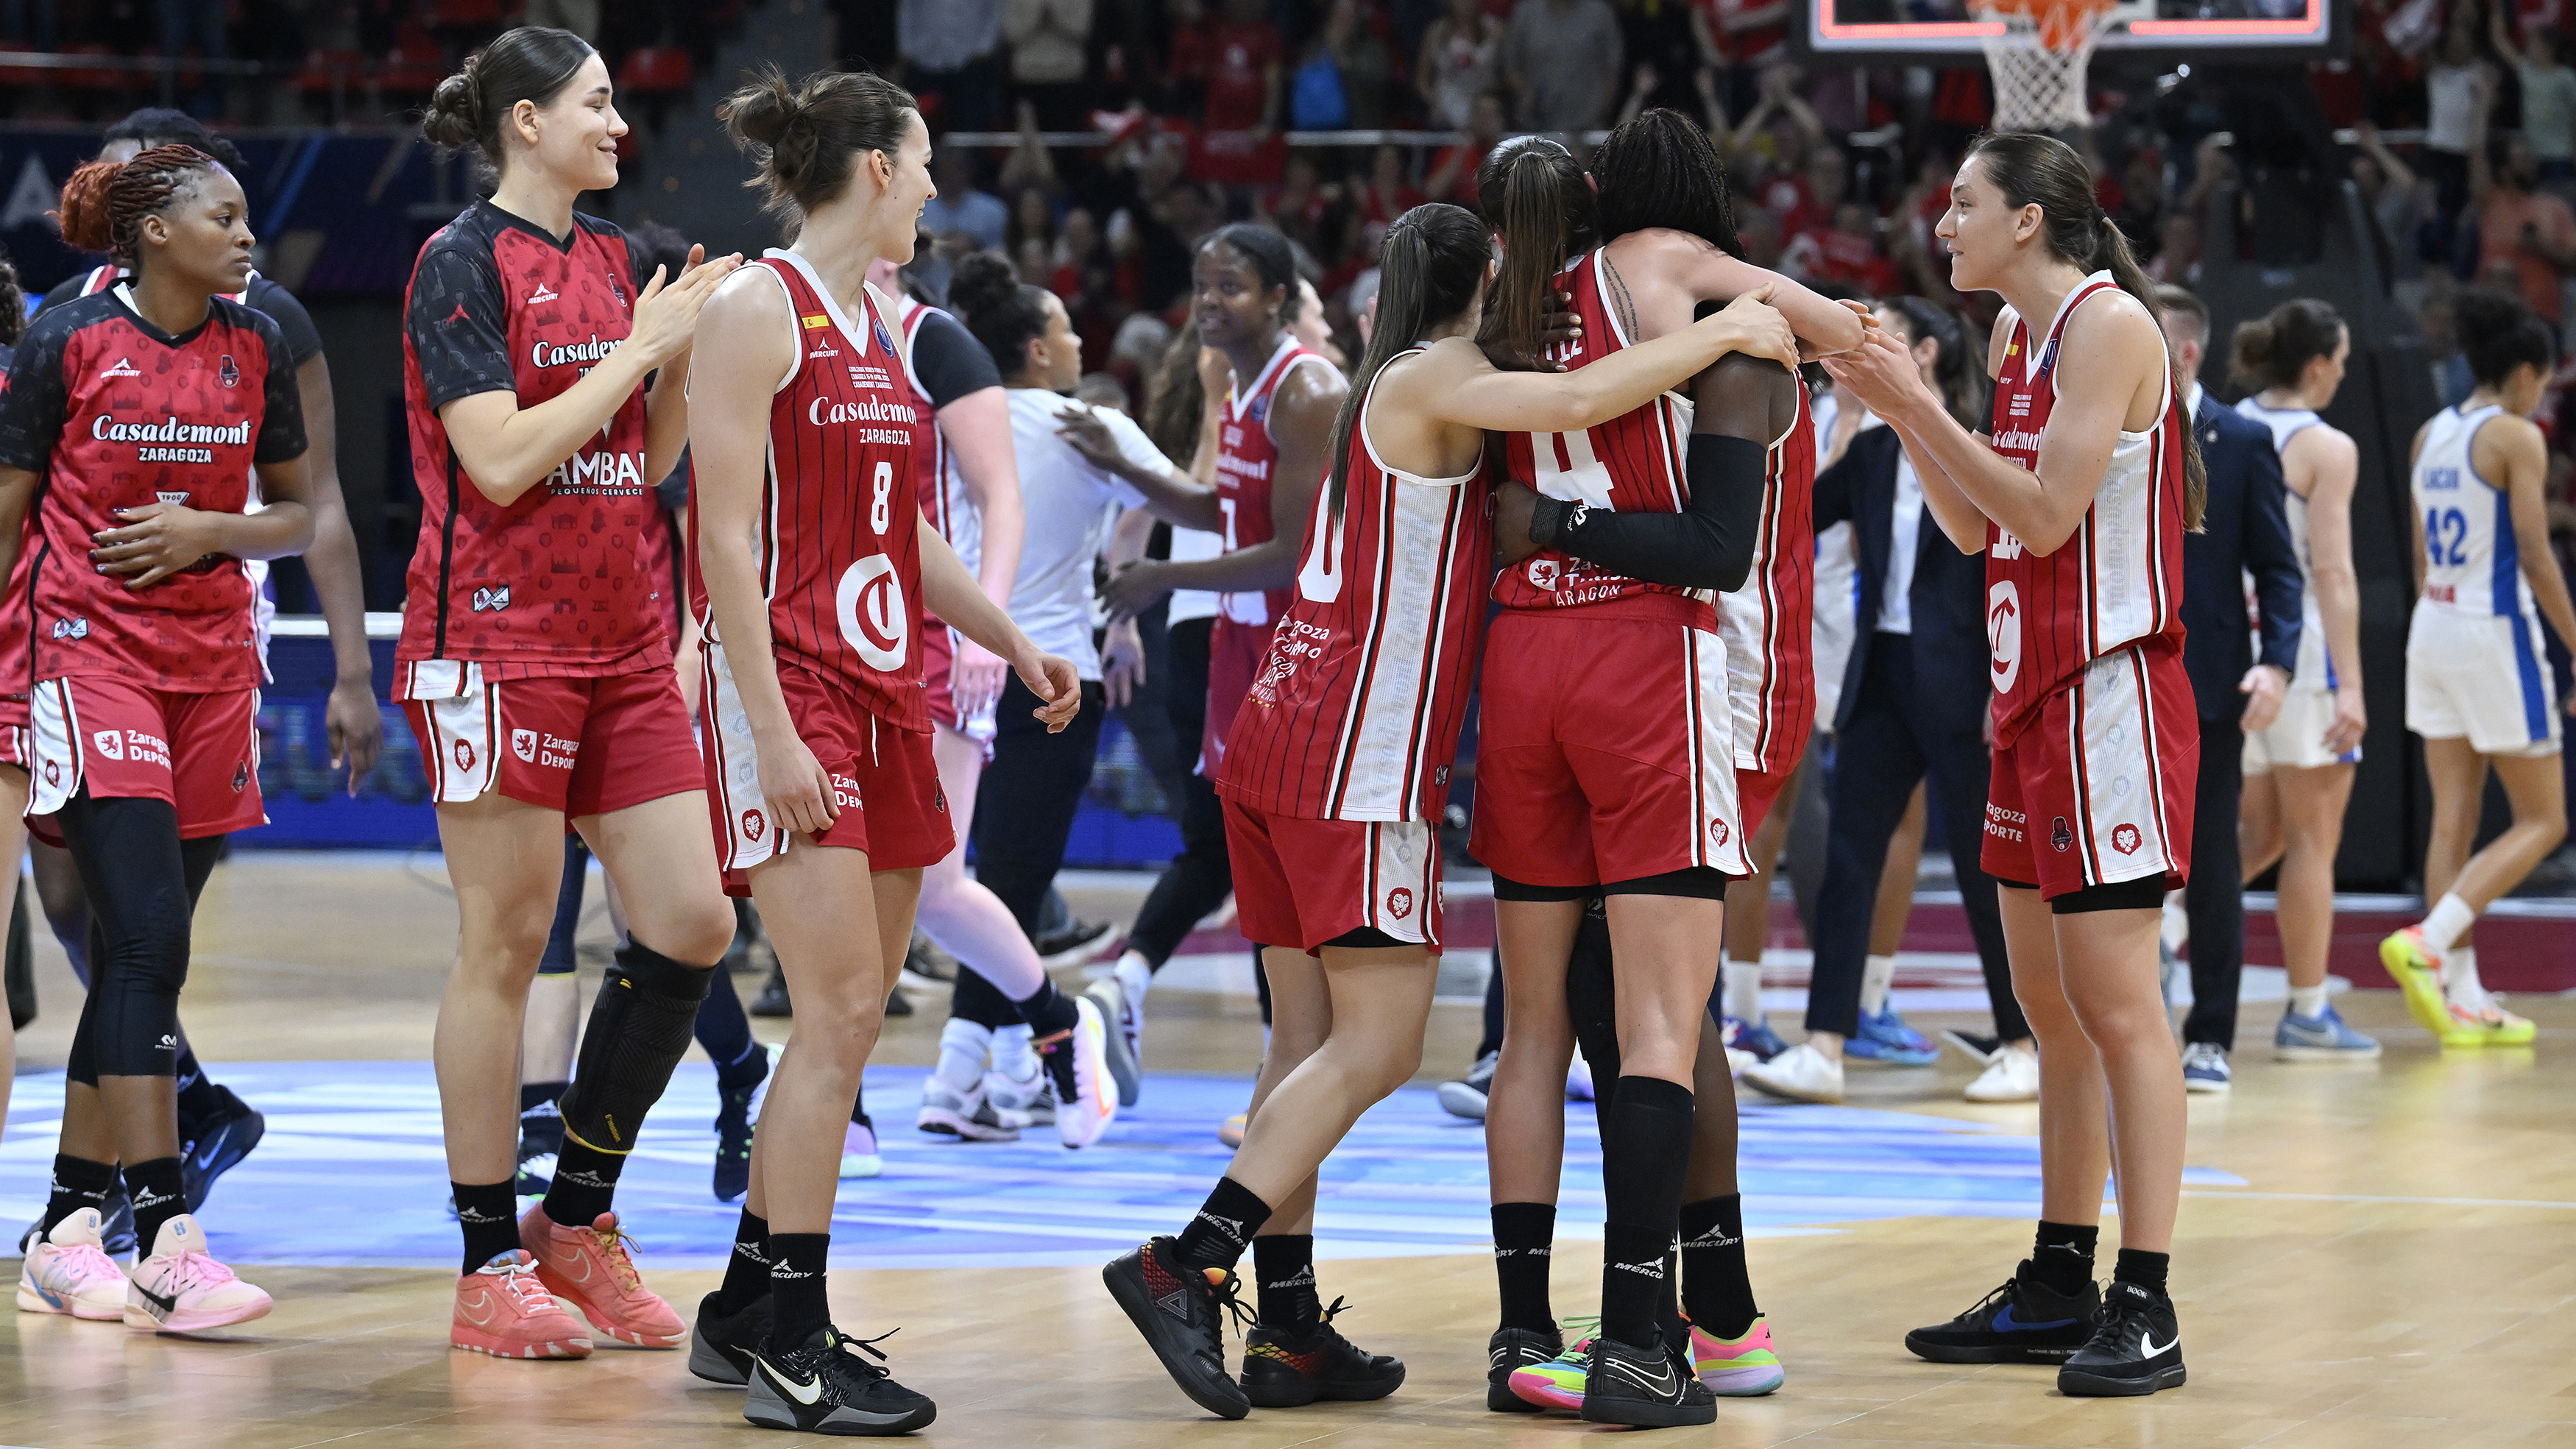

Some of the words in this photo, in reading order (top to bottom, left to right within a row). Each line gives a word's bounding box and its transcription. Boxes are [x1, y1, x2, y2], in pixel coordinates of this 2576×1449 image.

[528, 293, 559, 304] MERCURY
[532, 333, 625, 368] Casade
[810, 349, 839, 360] MERCURY
[809, 394, 919, 427] Casademo
[92, 414, 252, 444] Casademont
[860, 428, 911, 446] ZARAGOZA
[138, 447, 212, 463] ZARAGOZA
[551, 486, 599, 495] PEQUEÑOS
[603, 487, 643, 496] CERVECE
[871, 461, 893, 535] 8
[832, 773, 861, 798] Zara
[1680, 1236, 1742, 1248] MERCURY
[1614, 1262, 1664, 1280] MERCU
[2126, 1285, 2148, 1300] BOOK
